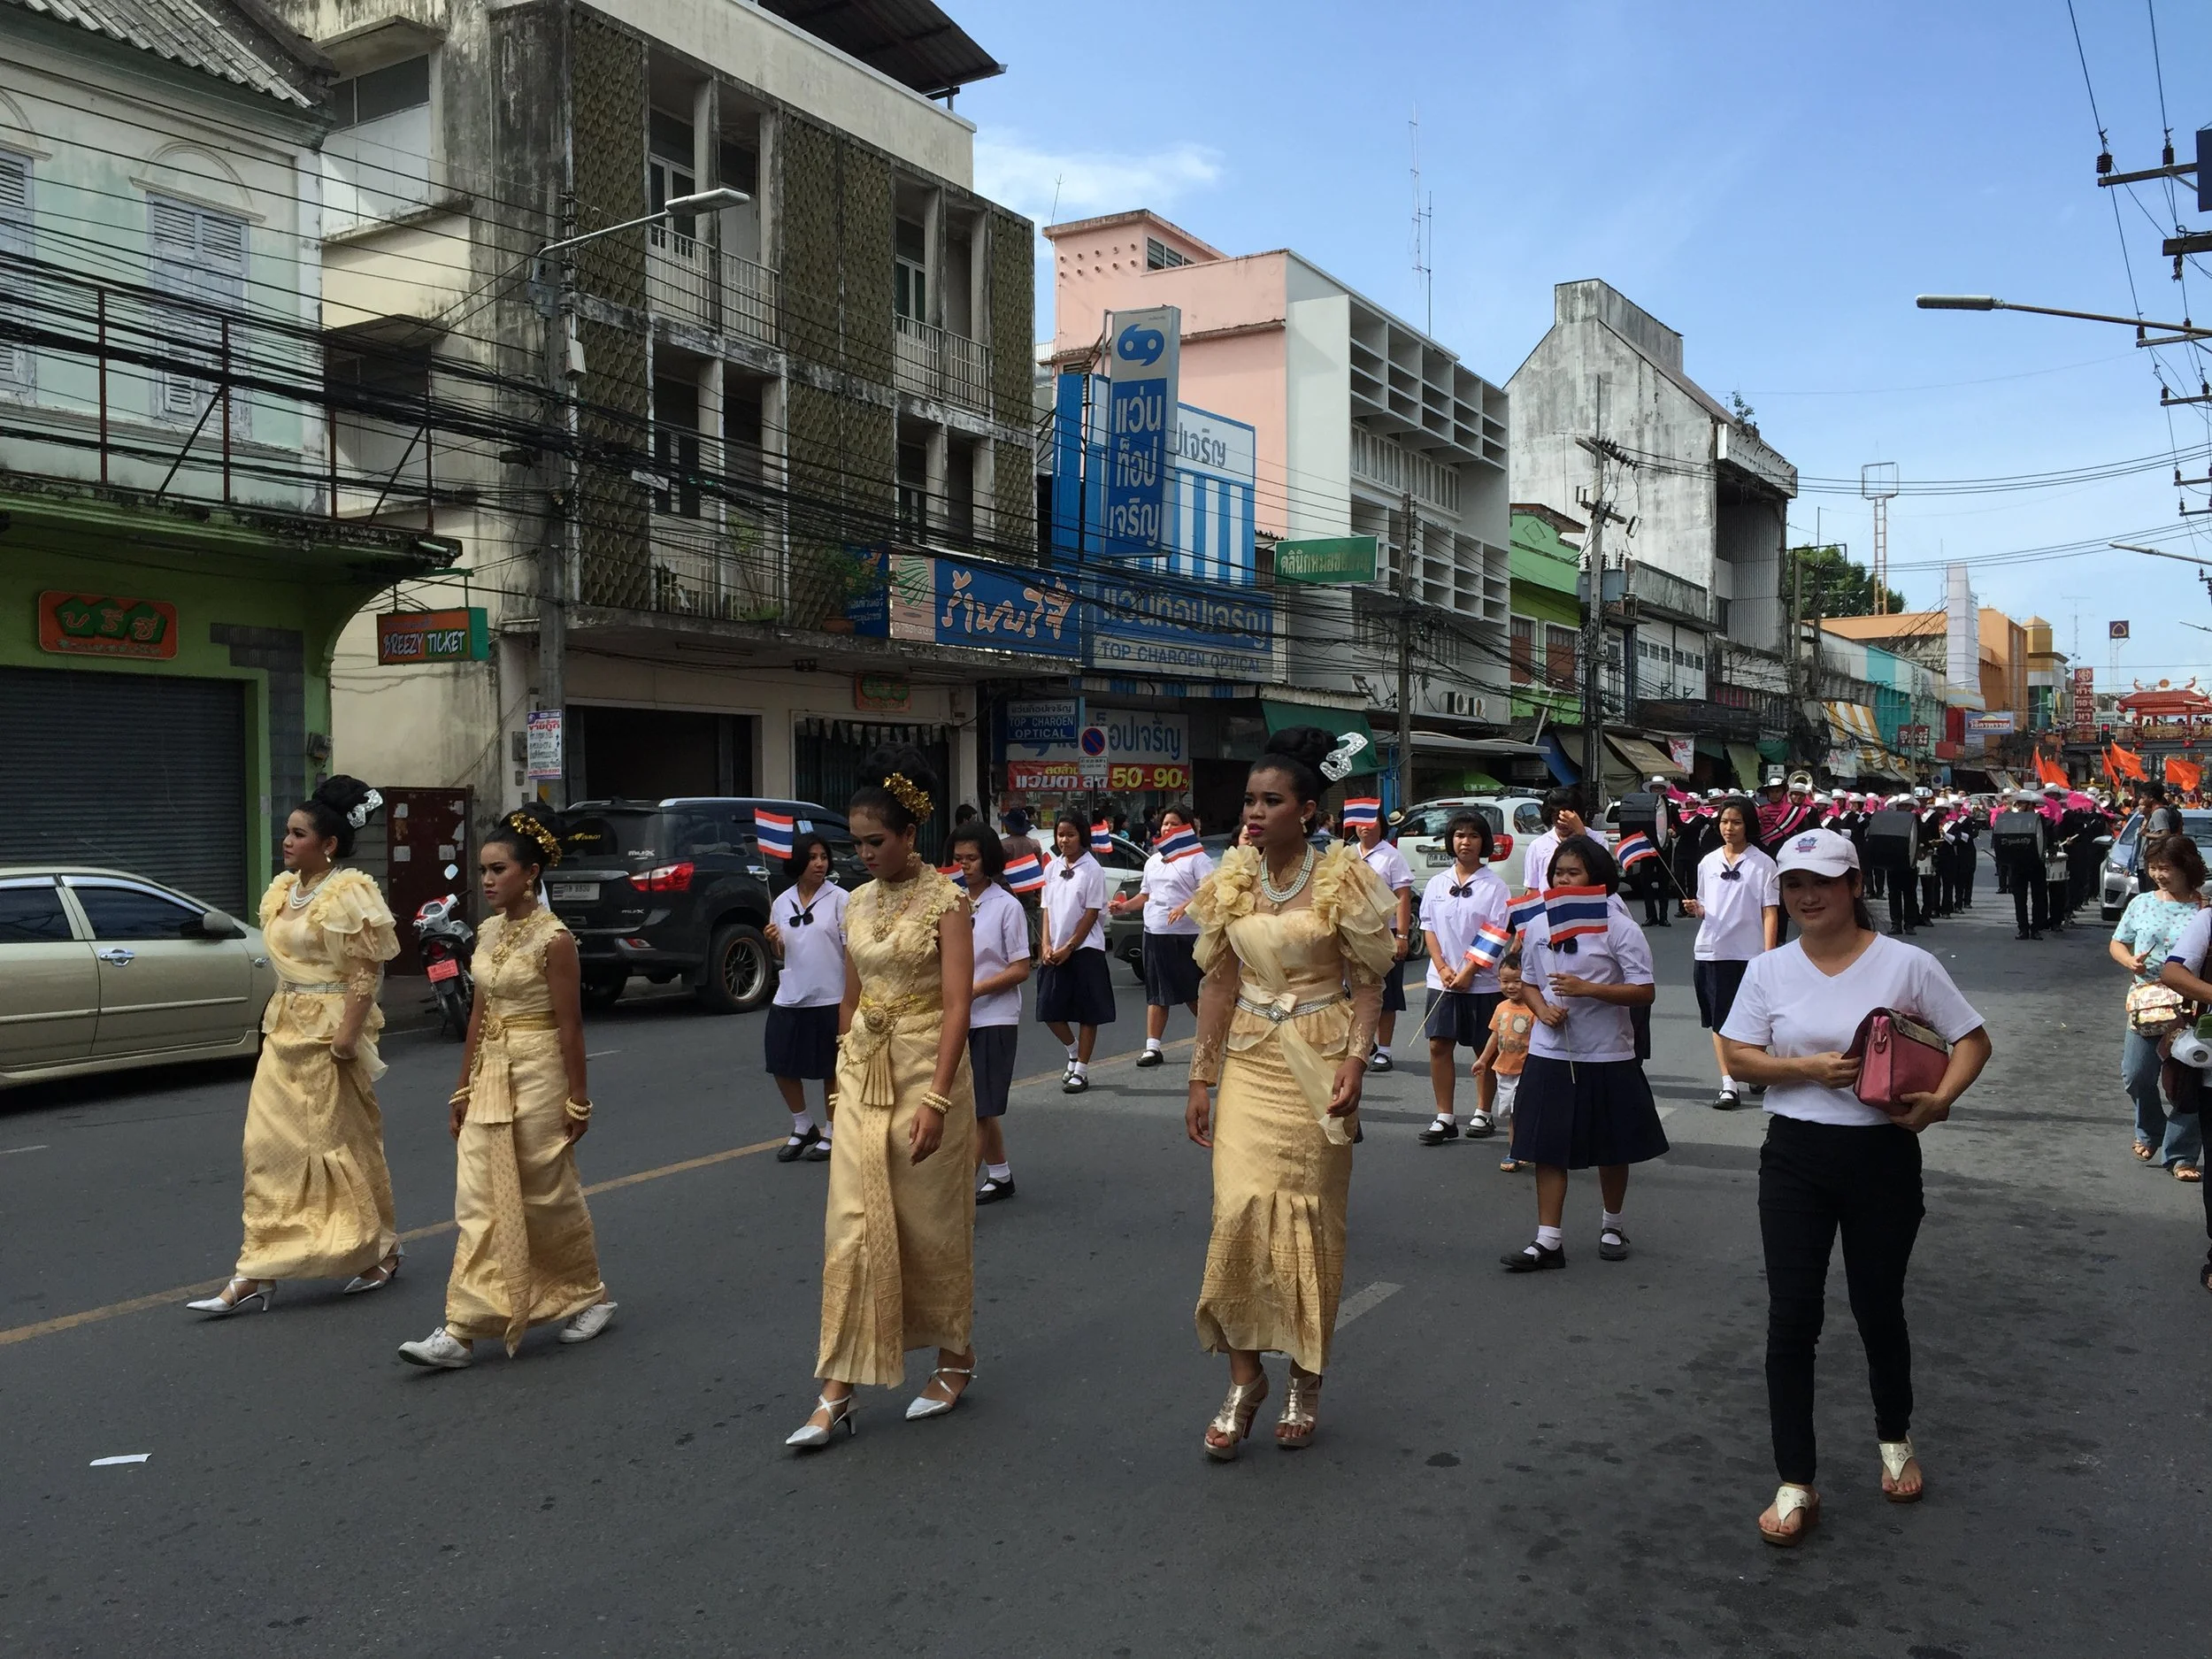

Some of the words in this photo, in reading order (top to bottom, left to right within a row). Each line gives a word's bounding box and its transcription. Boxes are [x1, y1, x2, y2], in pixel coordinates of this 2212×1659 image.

[1115, 386, 1162, 434] แว่น
[1116, 435, 1158, 488] ท็อป
[1109, 497, 1160, 546] เจริญ
[382, 633, 424, 658] BREEZY
[427, 631, 465, 653] TICKET
[1101, 641, 1132, 659] TOP
[1137, 646, 1206, 667] CHAROEN
[1210, 654, 1263, 673] OPTICAL
[1010, 718, 1026, 727] TOP
[1032, 717, 1074, 727] CHAROEN
[1015, 728, 1067, 739] OPTICAL
[1016, 772, 1078, 788] แว่นตา
